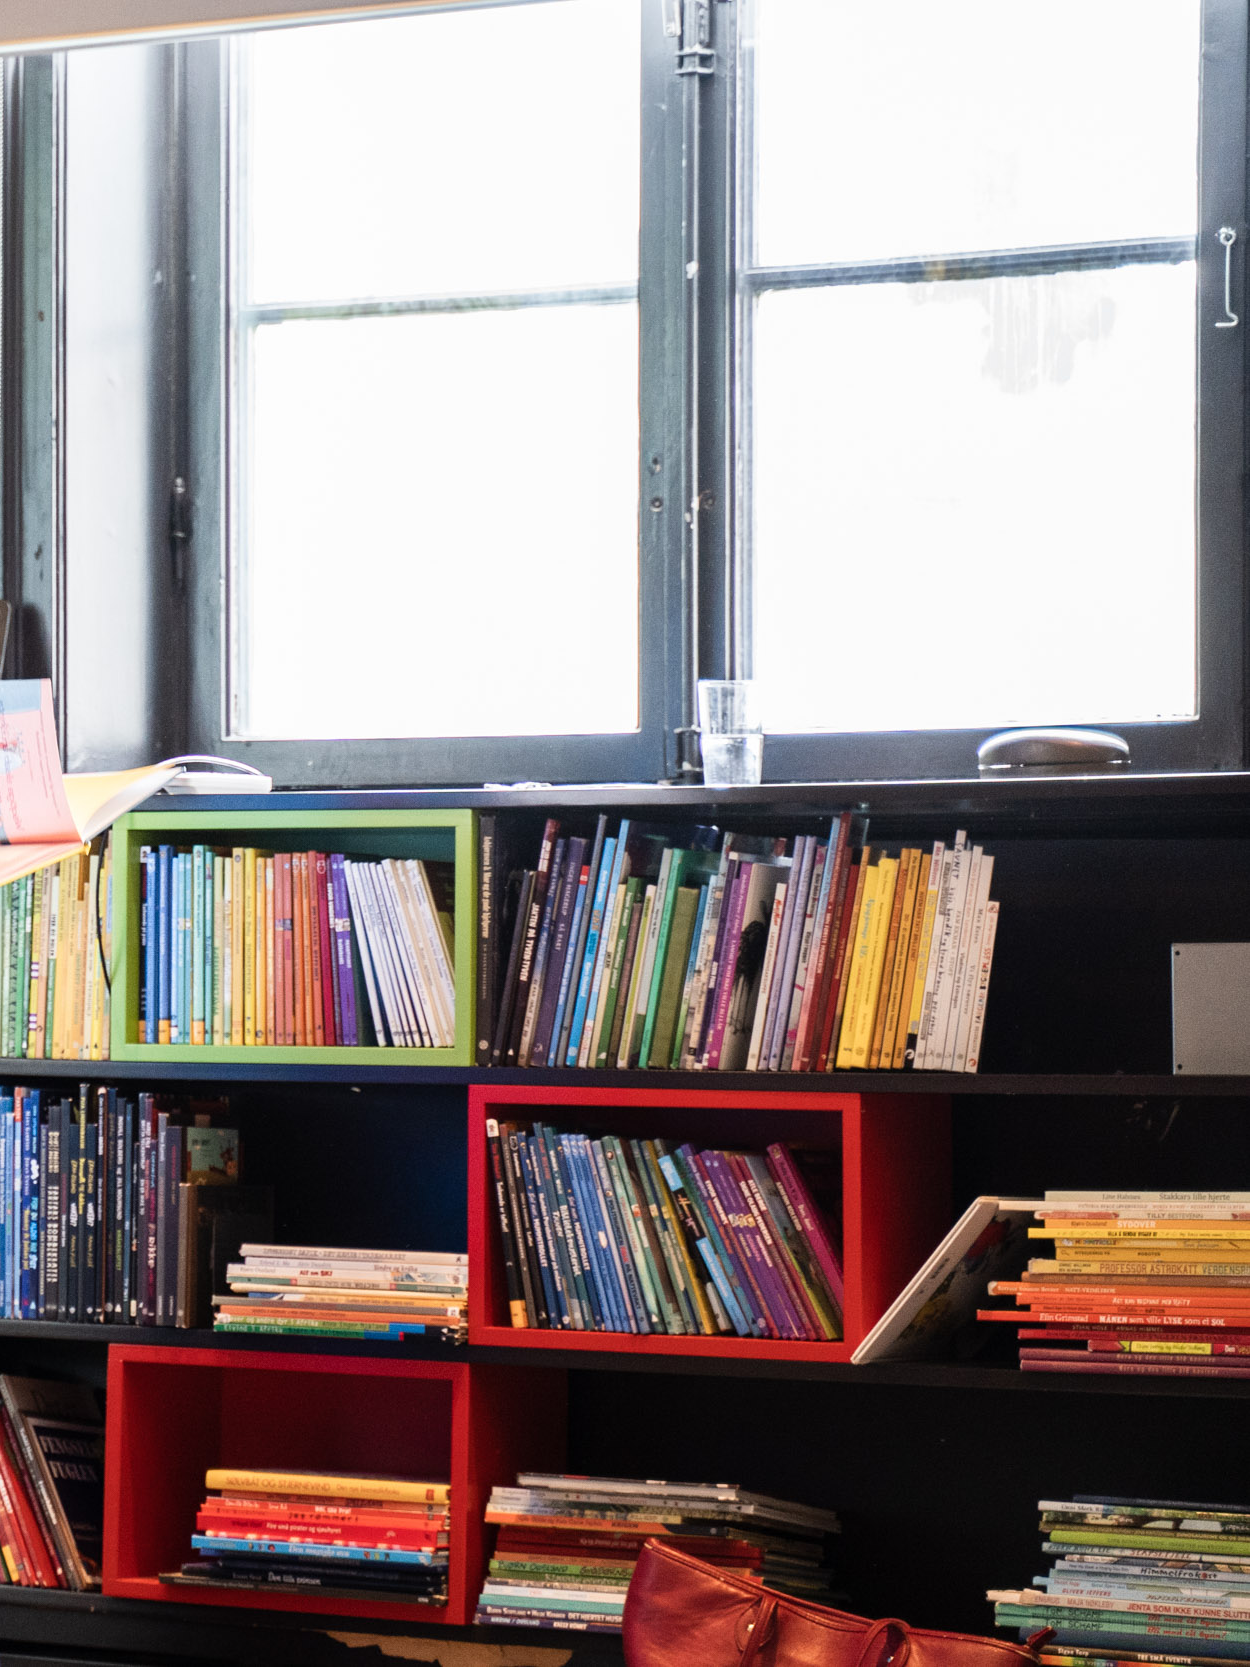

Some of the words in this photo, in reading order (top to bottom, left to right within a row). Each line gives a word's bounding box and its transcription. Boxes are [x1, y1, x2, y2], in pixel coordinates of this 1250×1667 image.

[1192, 1193, 1207, 1201] lille
[1208, 1193, 1230, 1203] hjerte
[1100, 1264, 1147, 1274] PROFESSOR
[1150, 1264, 1198, 1275] ASTROKATT
[292, 1318, 319, 1326] Afrika
[1039, 1313, 1054, 1321] Elin
[1054, 1313, 1089, 1323] Grimstad
[1099, 1314, 1128, 1324] MÅNEN
[1146, 1316, 1162, 1324] ville
[1163, 1317, 1183, 1325] LYSE
[1210, 1318, 1226, 1327] SOL
[259, 1325, 284, 1333] Afrika
[262, 1480, 276, 1488] OG
[1045, 1607, 1063, 1616] TOM
[1068, 1608, 1105, 1618] SCHAMP
[1126, 1602, 1153, 1611] JENTA
[1153, 1604, 1171, 1613] SOM
[1173, 1606, 1192, 1615] IKKE
[1193, 1607, 1222, 1617] KUNNE
[1045, 1619, 1063, 1627] TOM
[1068, 1620, 1105, 1630] SCHAMP
[1165, 1655, 1192, 1665] EVENTYR
